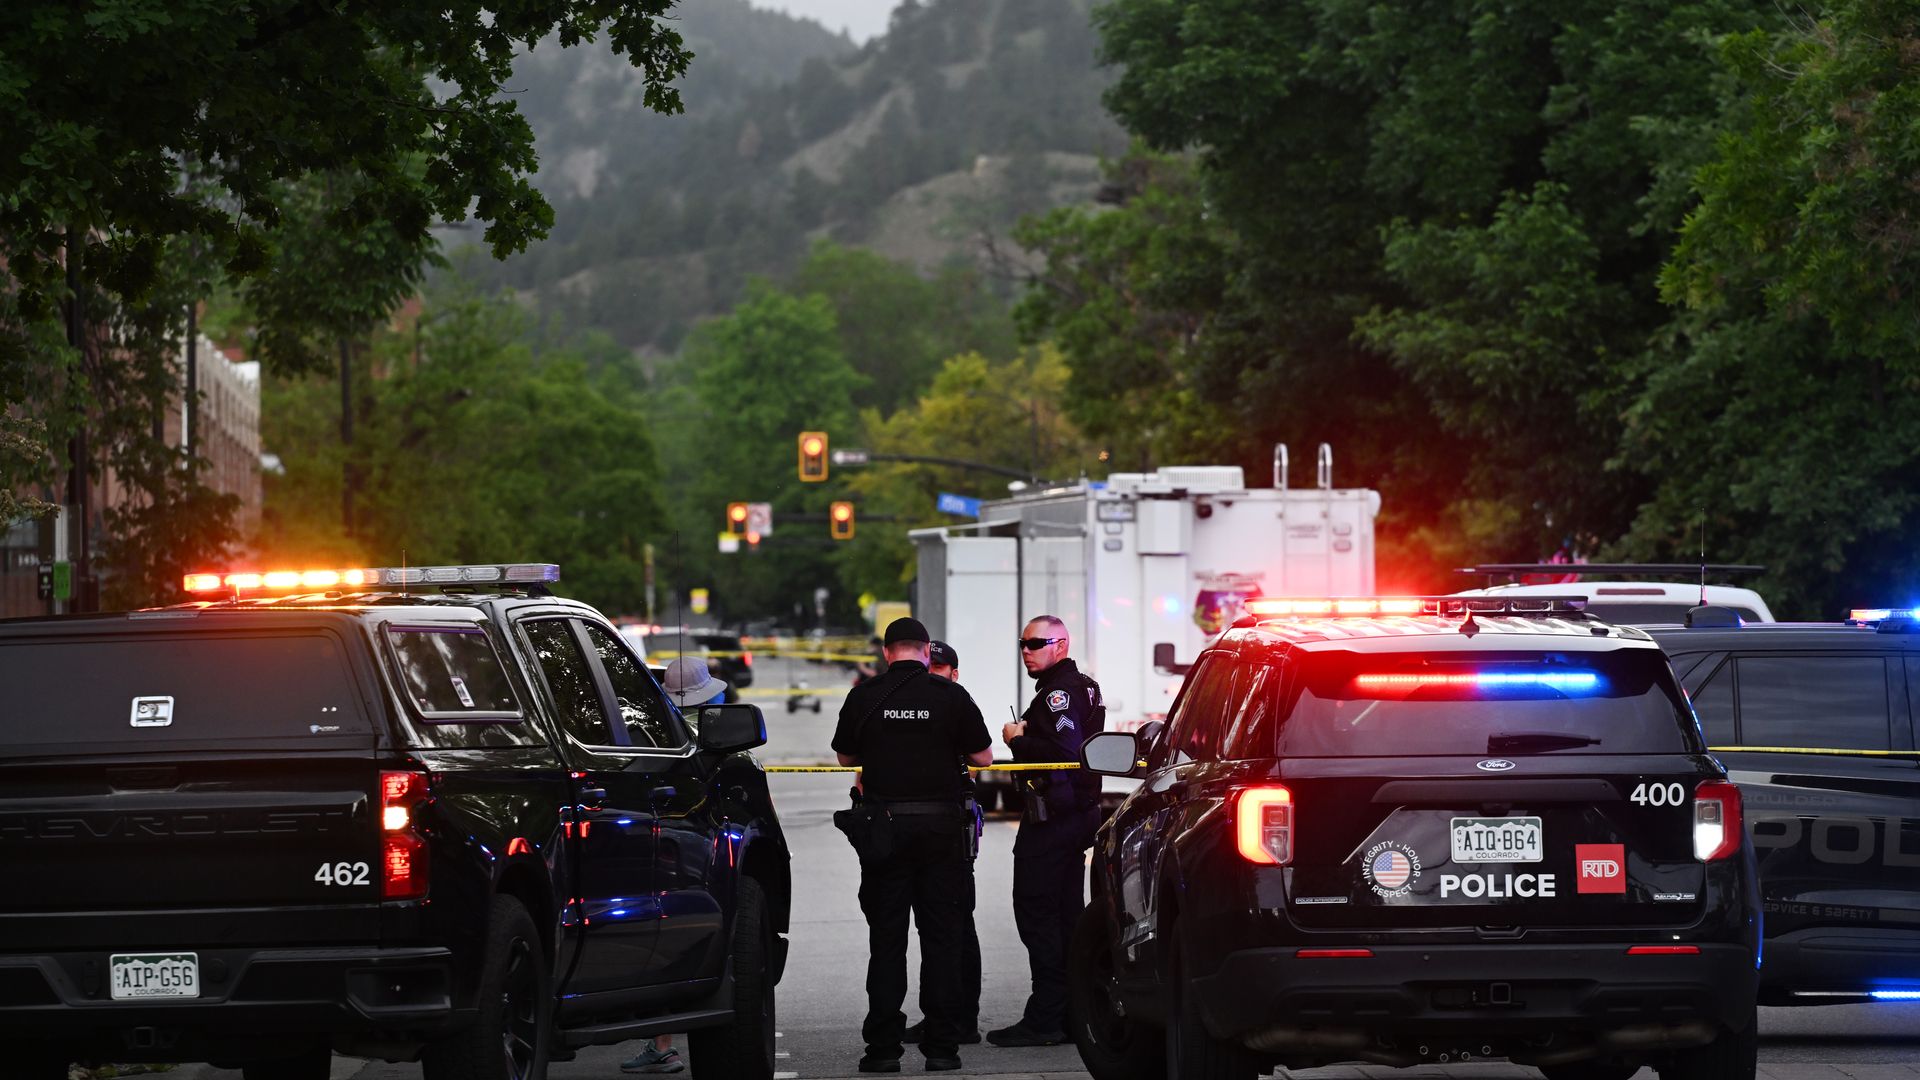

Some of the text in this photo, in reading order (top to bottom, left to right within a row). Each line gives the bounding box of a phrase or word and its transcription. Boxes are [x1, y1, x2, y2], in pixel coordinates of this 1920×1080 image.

[884, 710, 930, 720] POLICE K9
[1630, 783, 1684, 807] 400
[0, 811, 343, 839] HEVROLET
[1743, 809, 1920, 868] POL
[1362, 840, 1394, 880] INTEGRITY
[1401, 844, 1421, 878] HONOR
[1476, 851, 1519, 859] COLORADO
[314, 862, 370, 886] 462
[1582, 860, 1619, 878] RTD
[1371, 883, 1413, 899] RESPECT
[1440, 873, 1556, 898] POLICE
[1764, 902, 1807, 914] ERVICE
[134, 988, 177, 996] COLORADO
